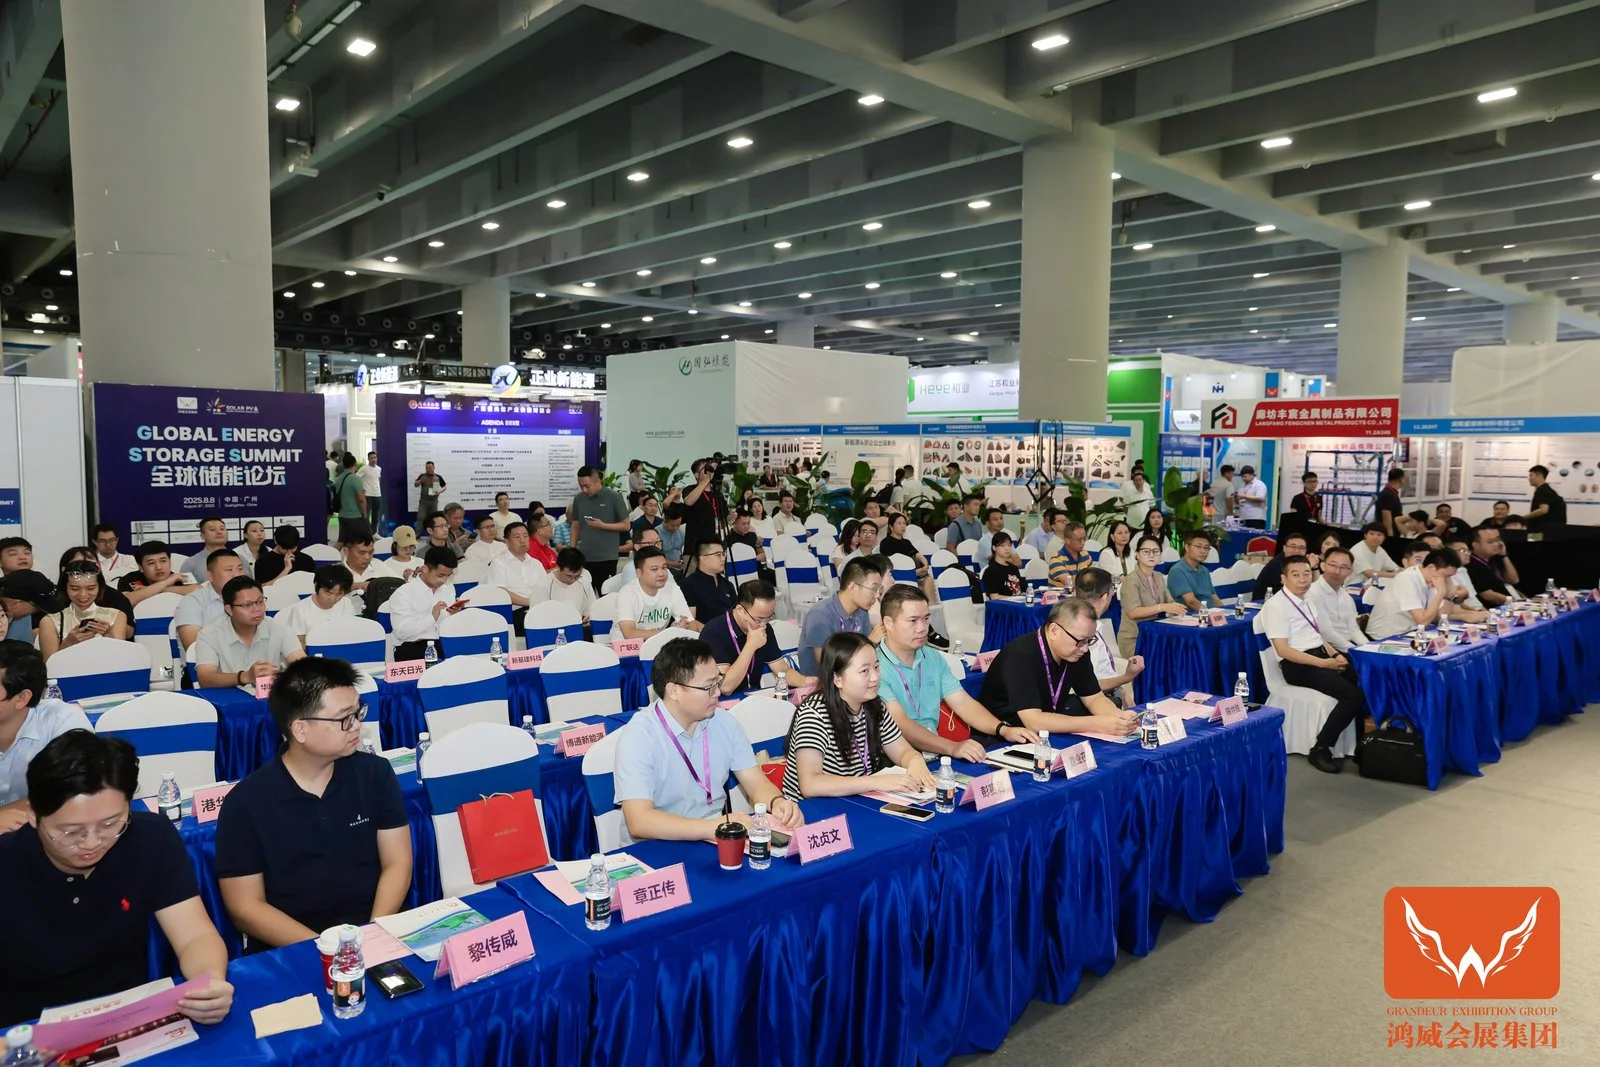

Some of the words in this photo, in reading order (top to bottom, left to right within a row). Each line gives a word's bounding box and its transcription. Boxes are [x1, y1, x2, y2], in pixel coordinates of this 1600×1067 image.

[529, 369, 596, 389] 正业新能源
[136, 425, 219, 442] GLOBAL
[221, 427, 295, 442] ENERGY
[128, 447, 226, 463] STORAGE
[229, 448, 303, 463] SUMMIT
[150, 465, 287, 488] 全球储能论坛
[183, 496, 215, 504] 2025.8.8
[619, 644, 640, 652] 广联达
[511, 655, 543, 665] 新基建科技
[390, 664, 424, 678] 东天日光
[807, 828, 841, 850] 沈贞文
[633, 879, 676, 905] 章正传
[467, 928, 518, 963] 黎传威
